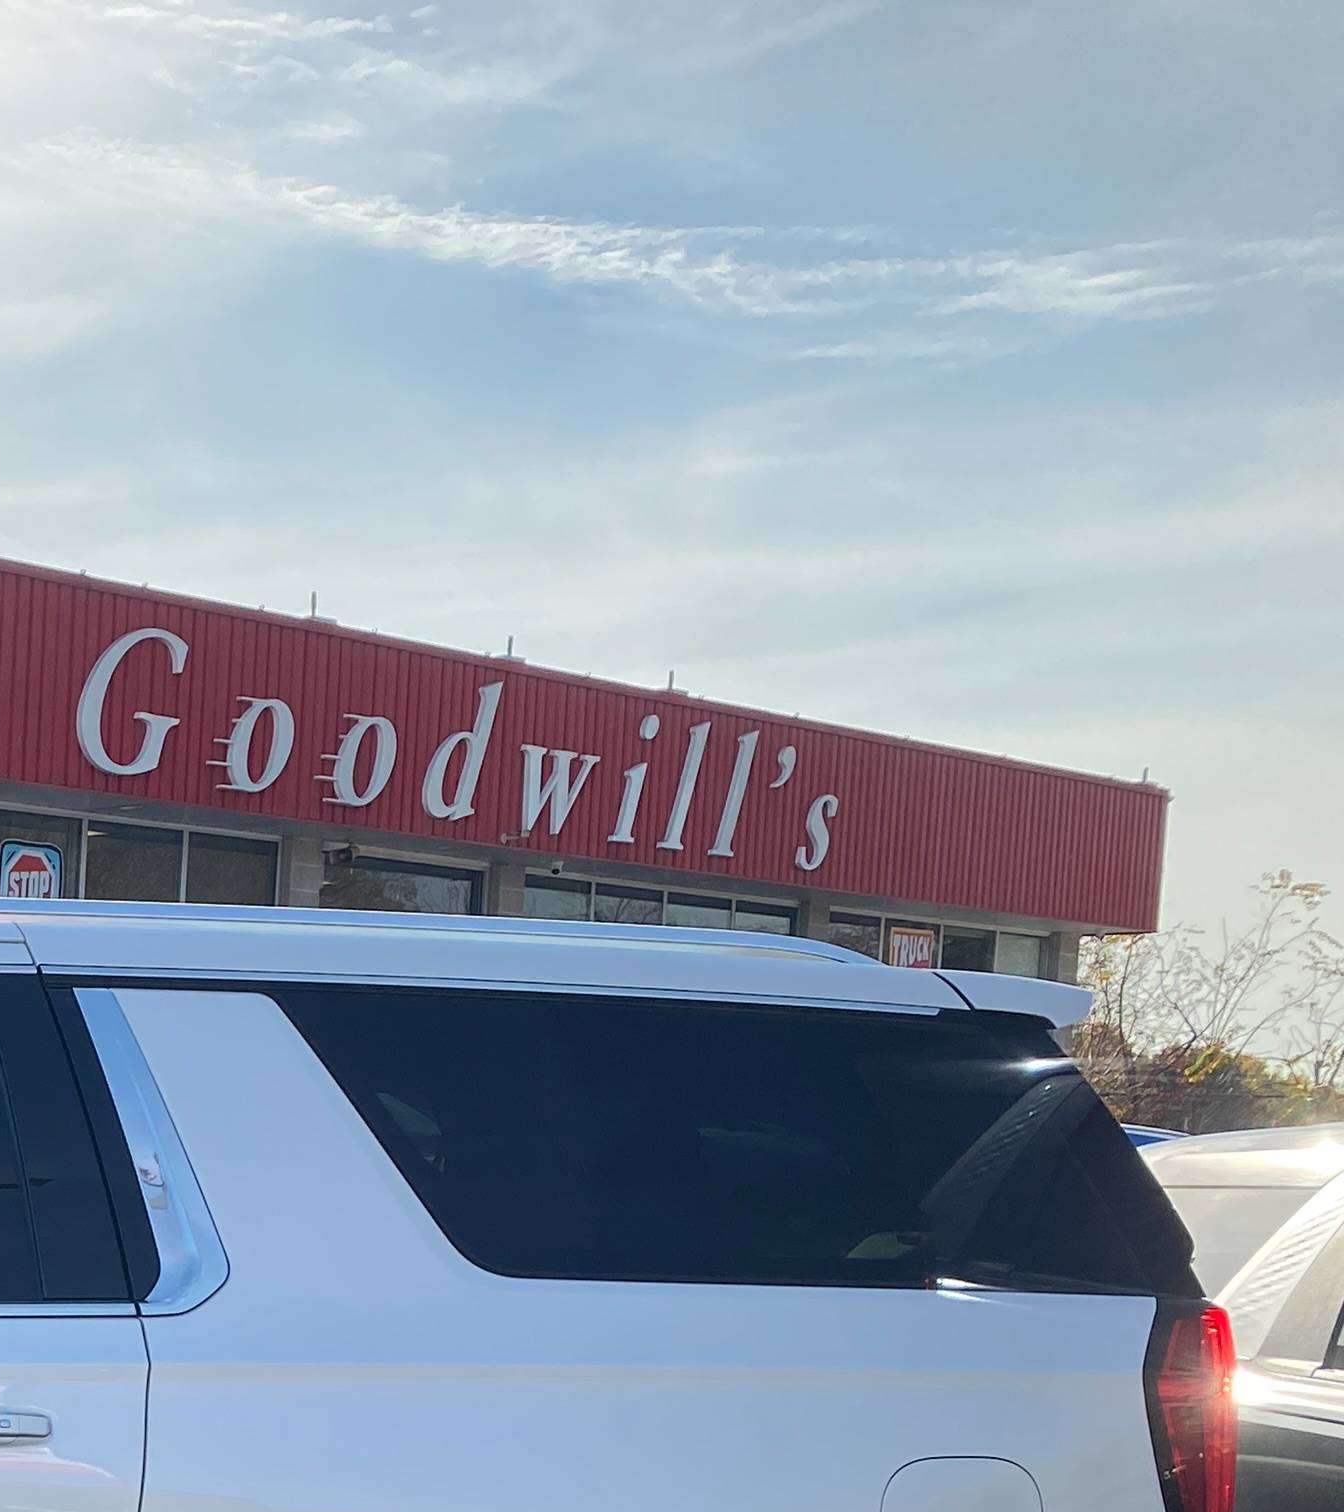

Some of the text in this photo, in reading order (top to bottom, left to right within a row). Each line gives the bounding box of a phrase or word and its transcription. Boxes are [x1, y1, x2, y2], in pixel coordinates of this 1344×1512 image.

[75, 626, 839, 872] Goodwill's
[8, 870, 50, 898] STOP
[893, 934, 929, 966] TRUCK
